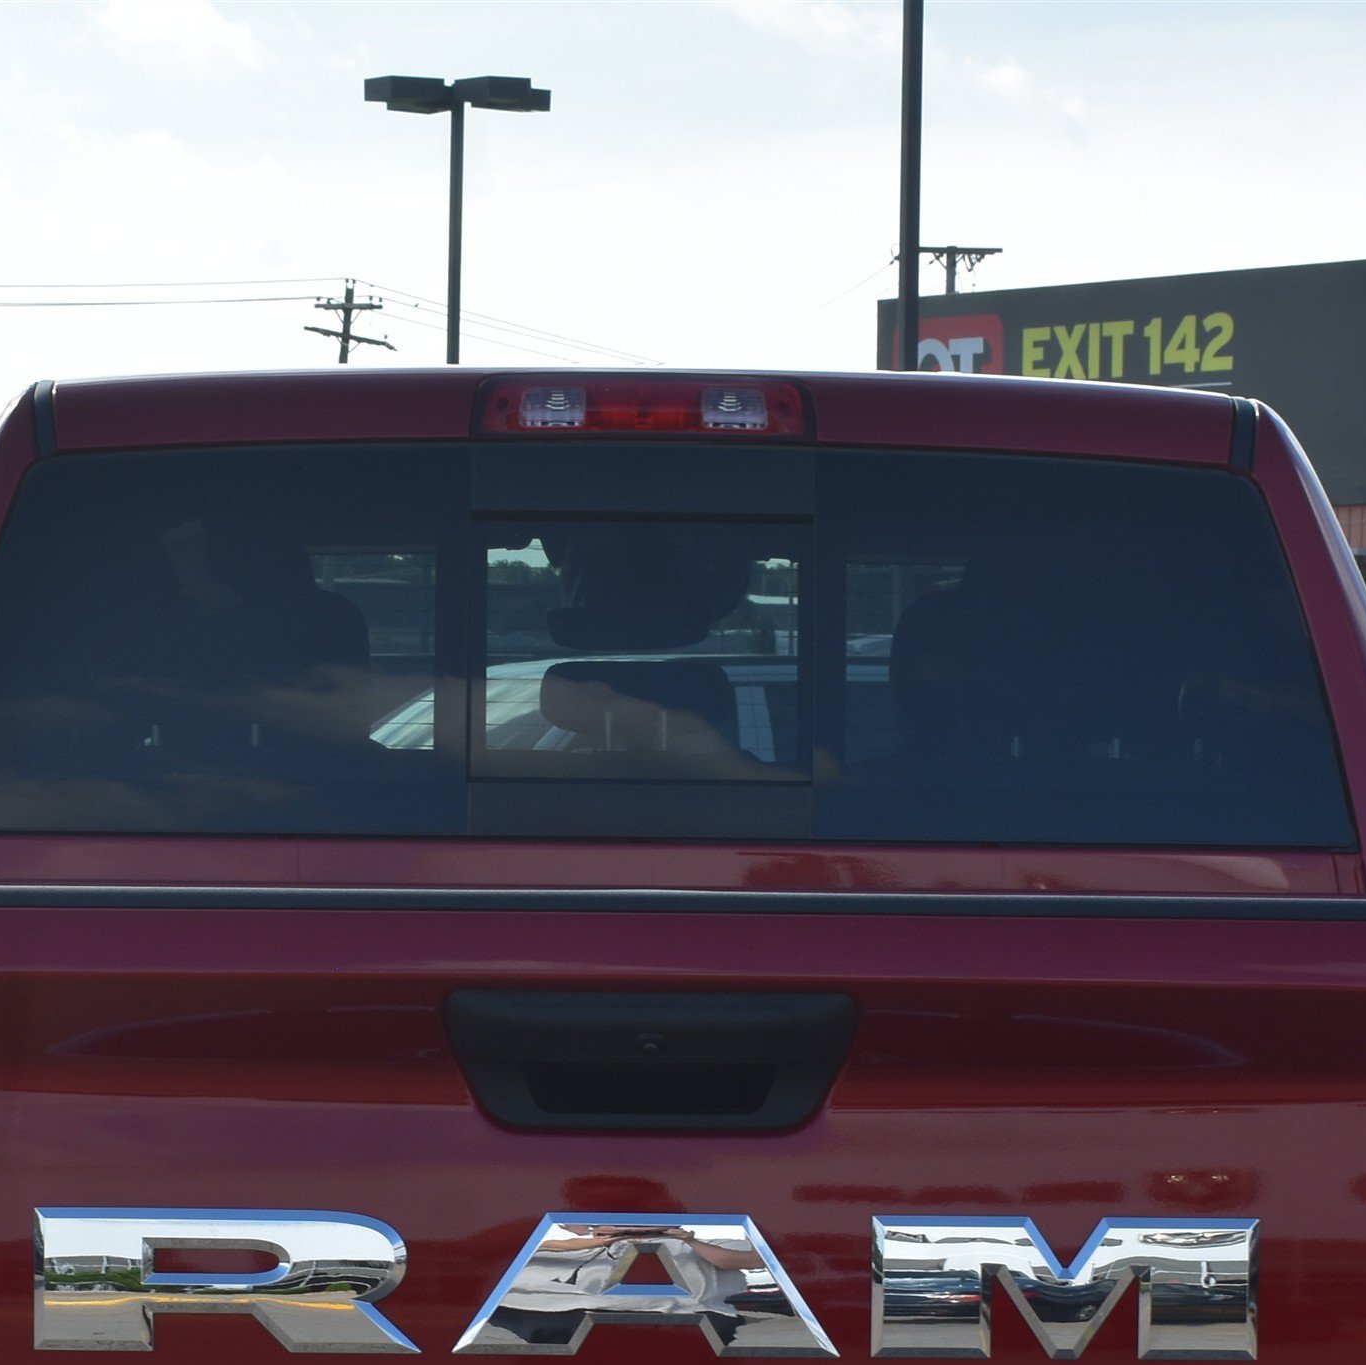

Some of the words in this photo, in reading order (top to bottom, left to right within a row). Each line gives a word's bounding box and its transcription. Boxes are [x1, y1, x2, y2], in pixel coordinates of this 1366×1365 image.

[1023, 319, 1134, 379] EXIT
[1144, 311, 1234, 376] 142
[34, 1206, 1261, 1360] RAM
